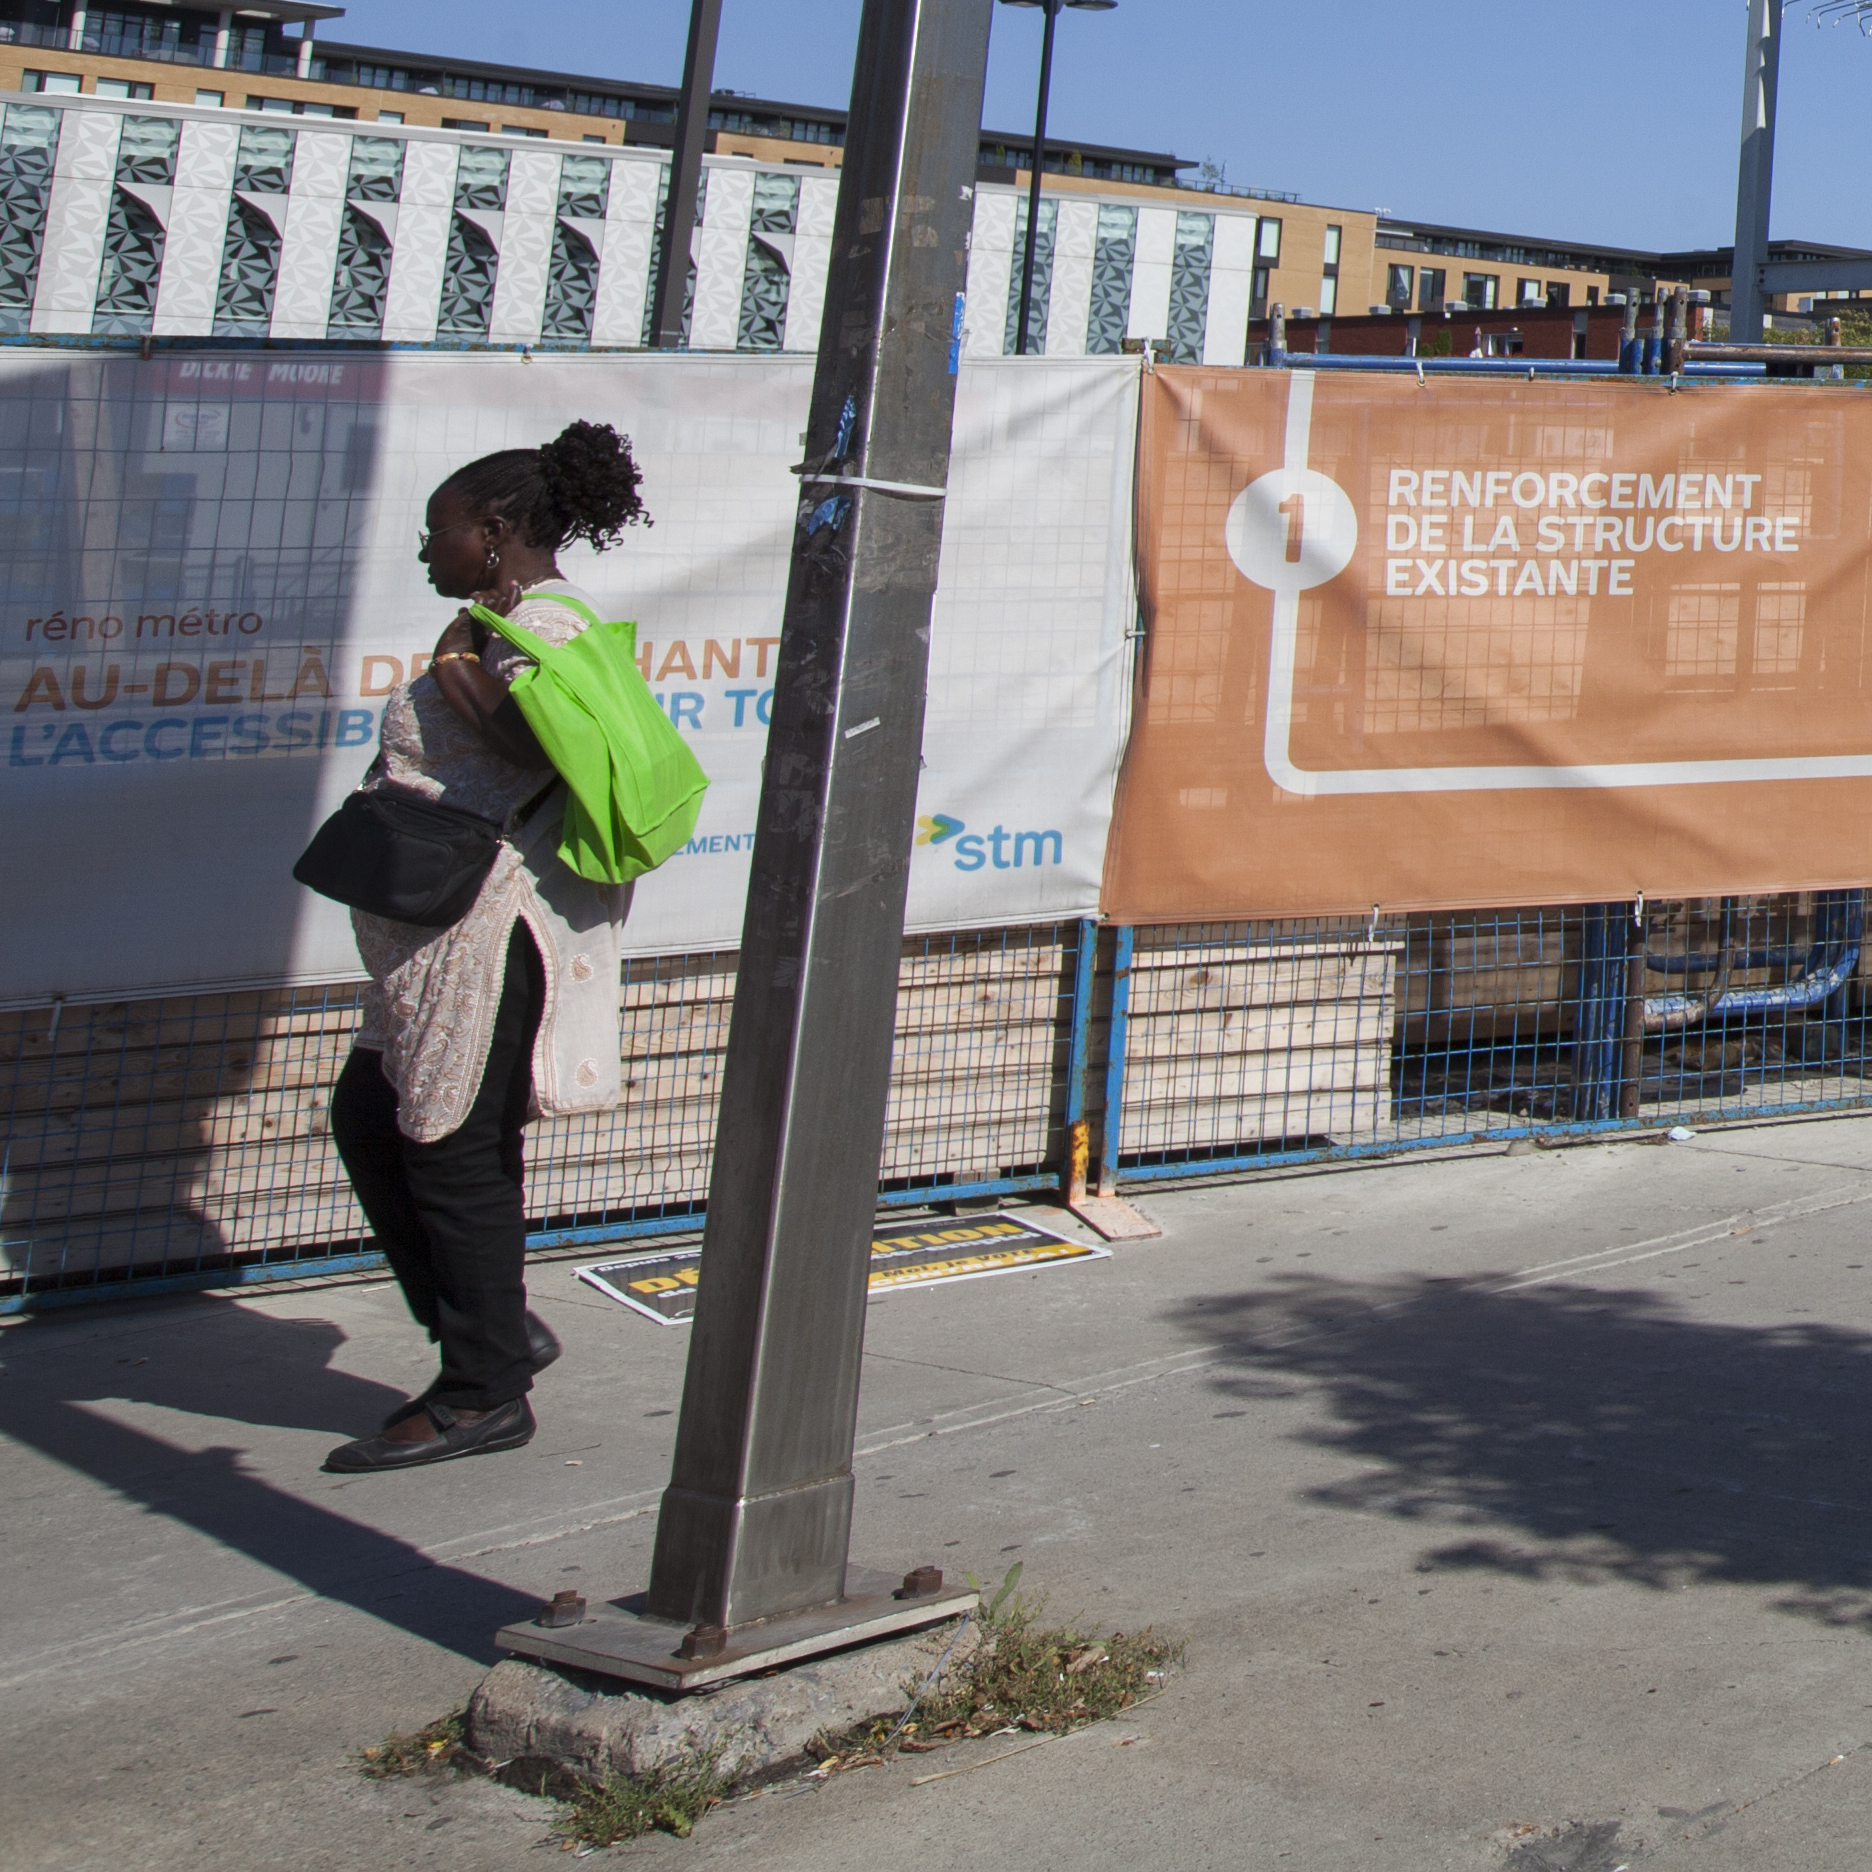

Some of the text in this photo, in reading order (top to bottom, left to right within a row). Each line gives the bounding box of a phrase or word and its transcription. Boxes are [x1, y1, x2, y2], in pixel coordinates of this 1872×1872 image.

[1388, 469, 1762, 509] RENFORCEMENT
[1277, 493, 1306, 564] 1
[1386, 514, 1800, 553] DE LA STRUCTURE
[1386, 559, 1636, 596] EXISTANTE
[26, 608, 263, 642] réno métro
[13, 646, 334, 713] AU-DELÀ
[8, 708, 387, 767] L'ACCESSIB
[954, 825, 1063, 872] stm
